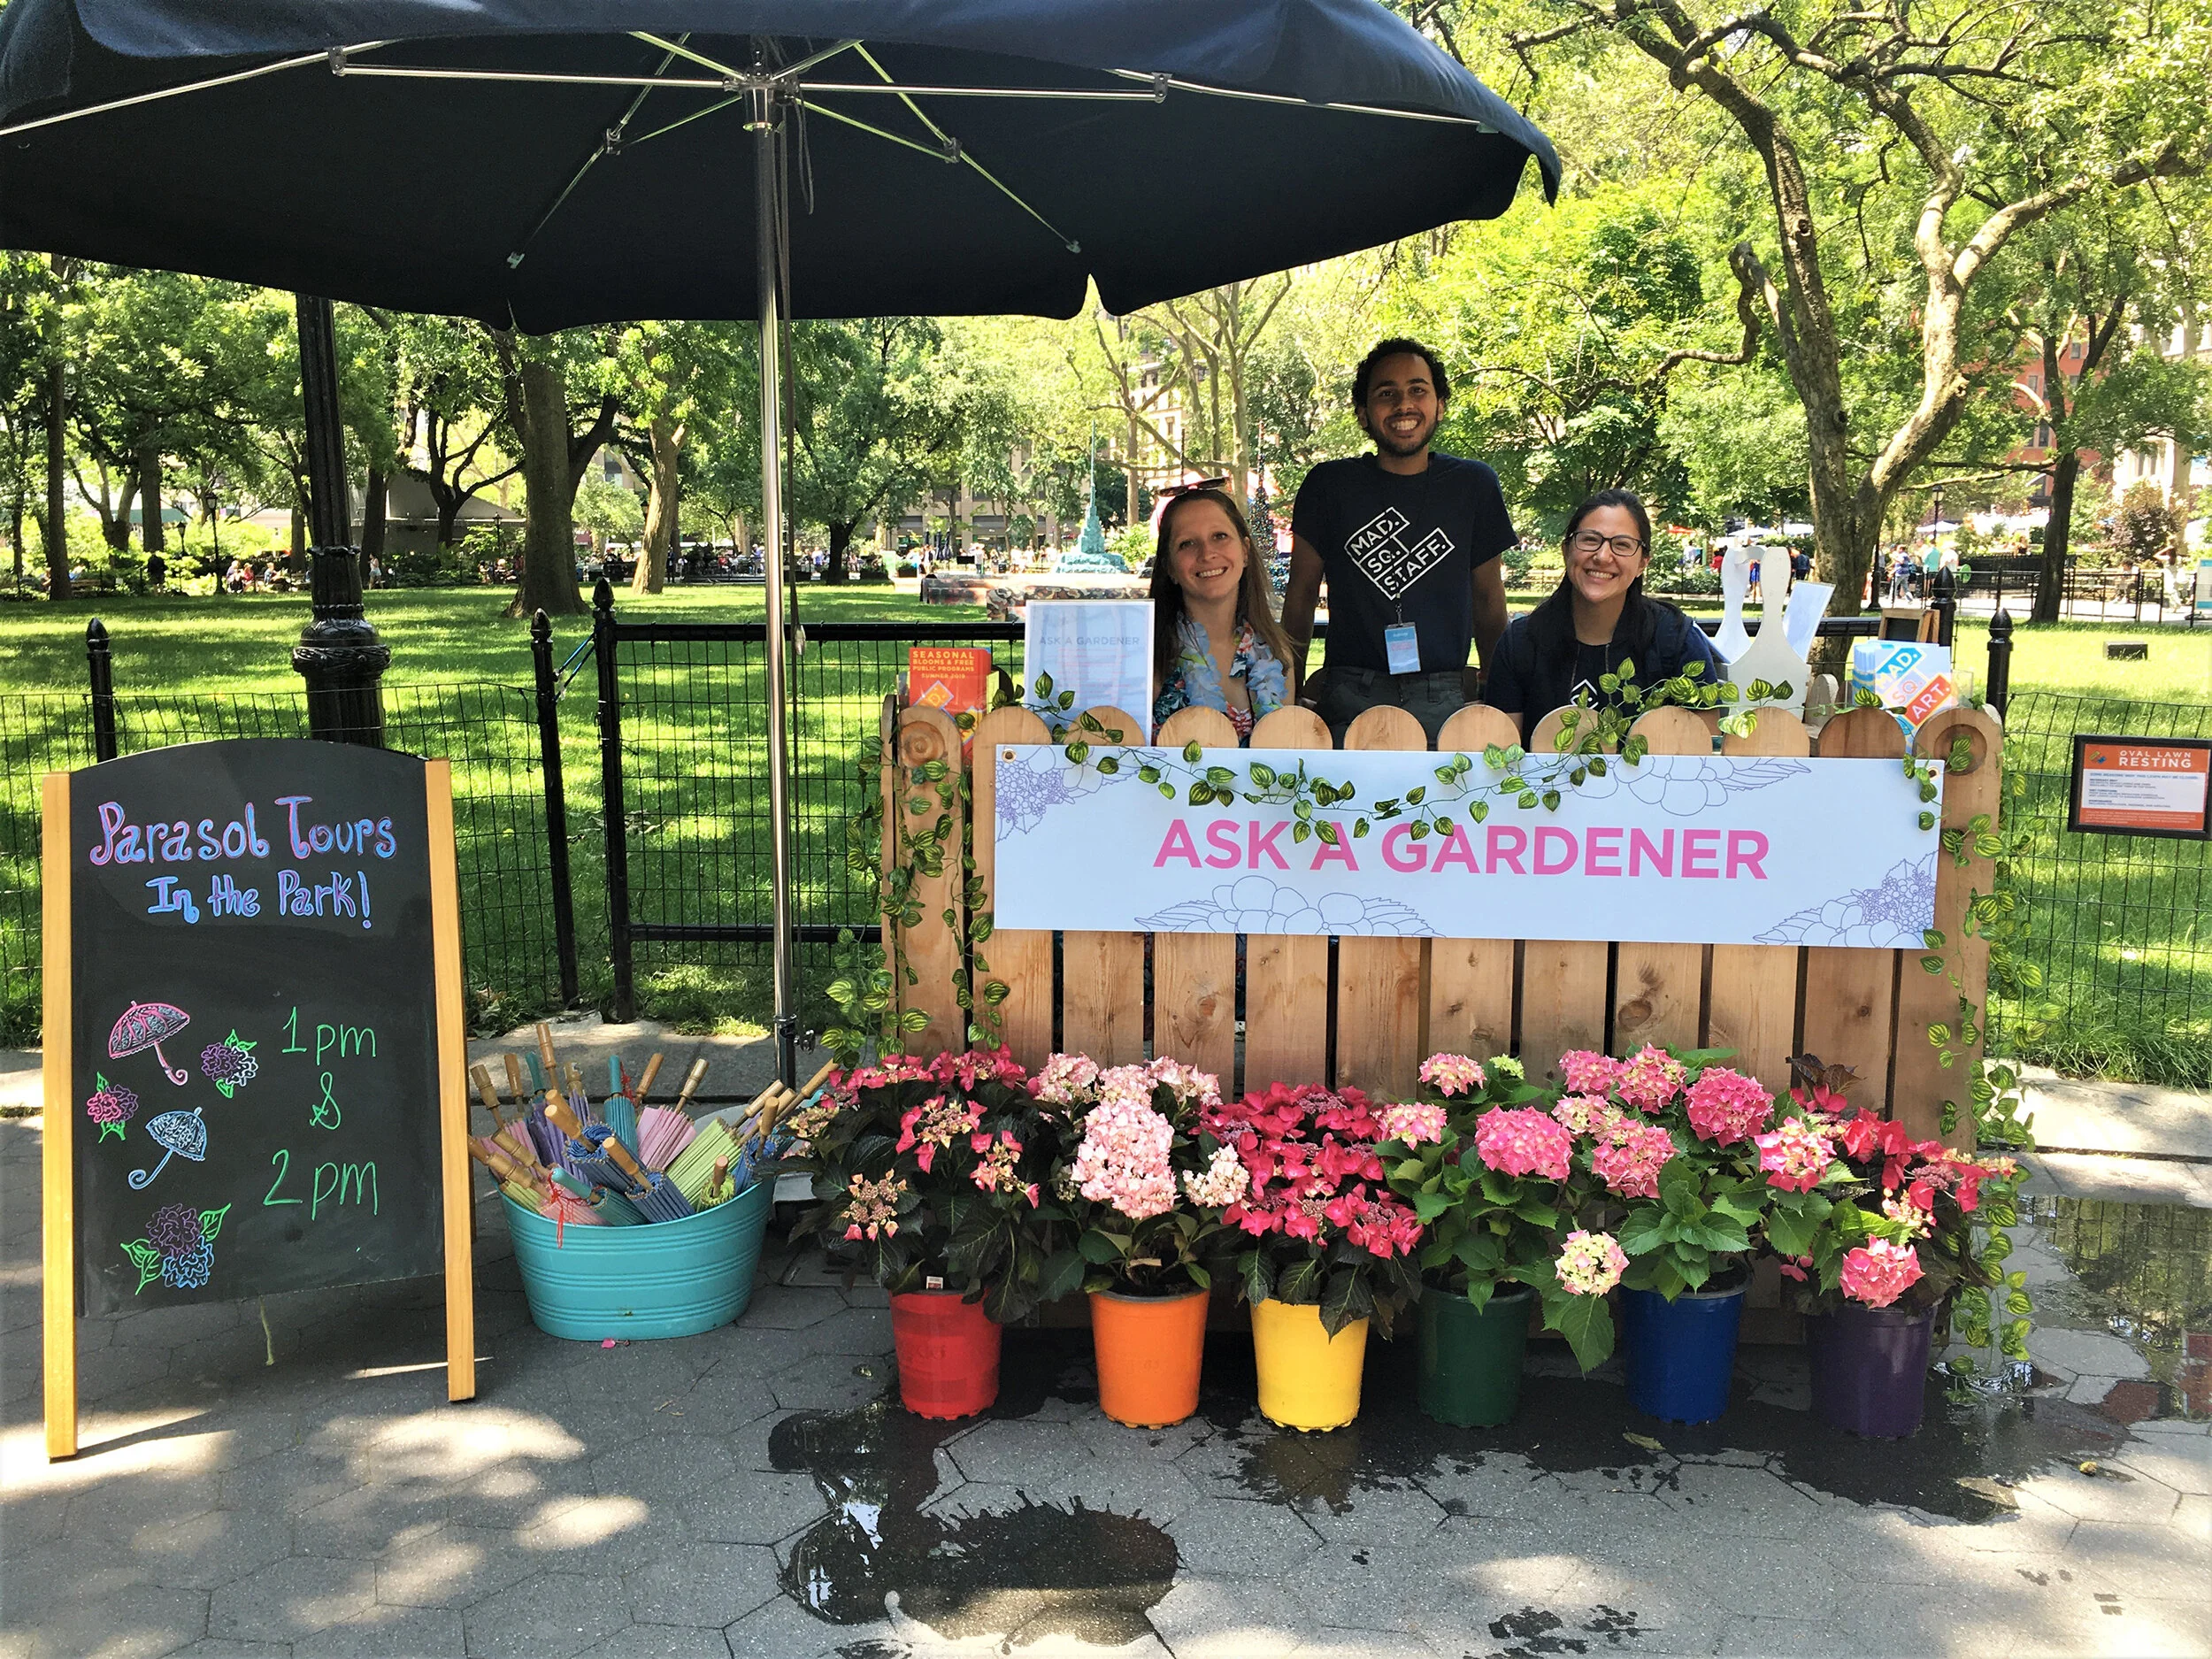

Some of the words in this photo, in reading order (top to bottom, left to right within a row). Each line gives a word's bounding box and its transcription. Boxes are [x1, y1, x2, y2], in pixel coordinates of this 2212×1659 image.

[1350, 518, 1400, 557] MAD.
[1367, 549, 1402, 573] SQ.
[1383, 538, 1447, 591] STAFF.
[912, 650, 974, 659] SEASONAL
[1039, 636, 1061, 645] ASK
[1076, 636, 1141, 645] GARDENER
[1911, 683, 1951, 719] ART.
[2118, 757, 2192, 768] RESTING
[89, 802, 271, 865] Parasol
[274, 795, 397, 860] Tours
[1153, 818, 1292, 870] ASK
[1310, 822, 1360, 871] A
[1381, 822, 1770, 879] GARDENER
[145, 875, 201, 925] In
[206, 873, 261, 918] the
[277, 869, 372, 929] Park!
